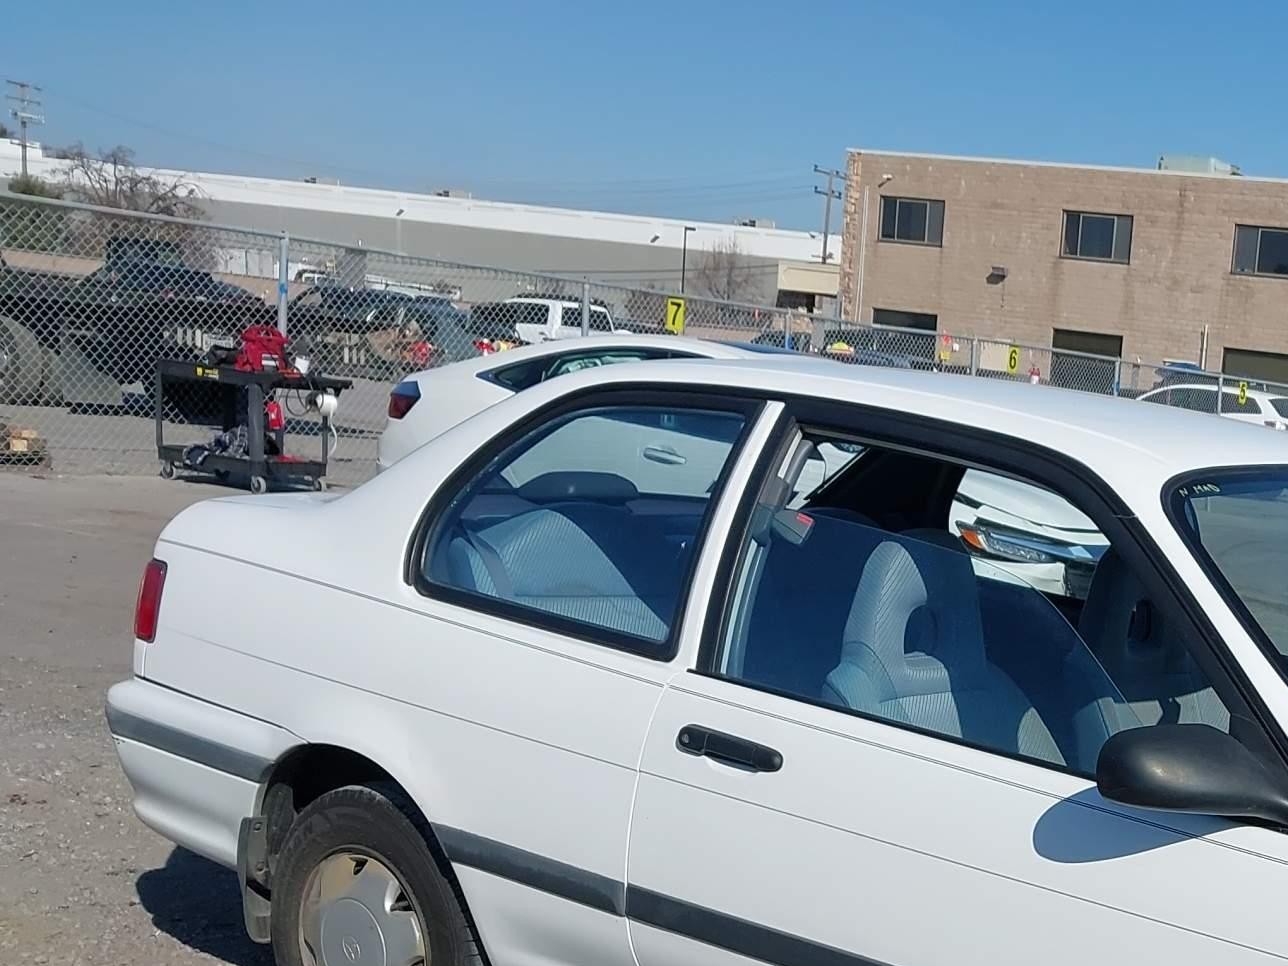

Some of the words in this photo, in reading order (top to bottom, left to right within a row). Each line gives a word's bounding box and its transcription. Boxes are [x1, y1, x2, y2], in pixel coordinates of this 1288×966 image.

[670, 301, 682, 326] 7
[1009, 349, 1018, 370] 6
[1240, 383, 1247, 400] 5
